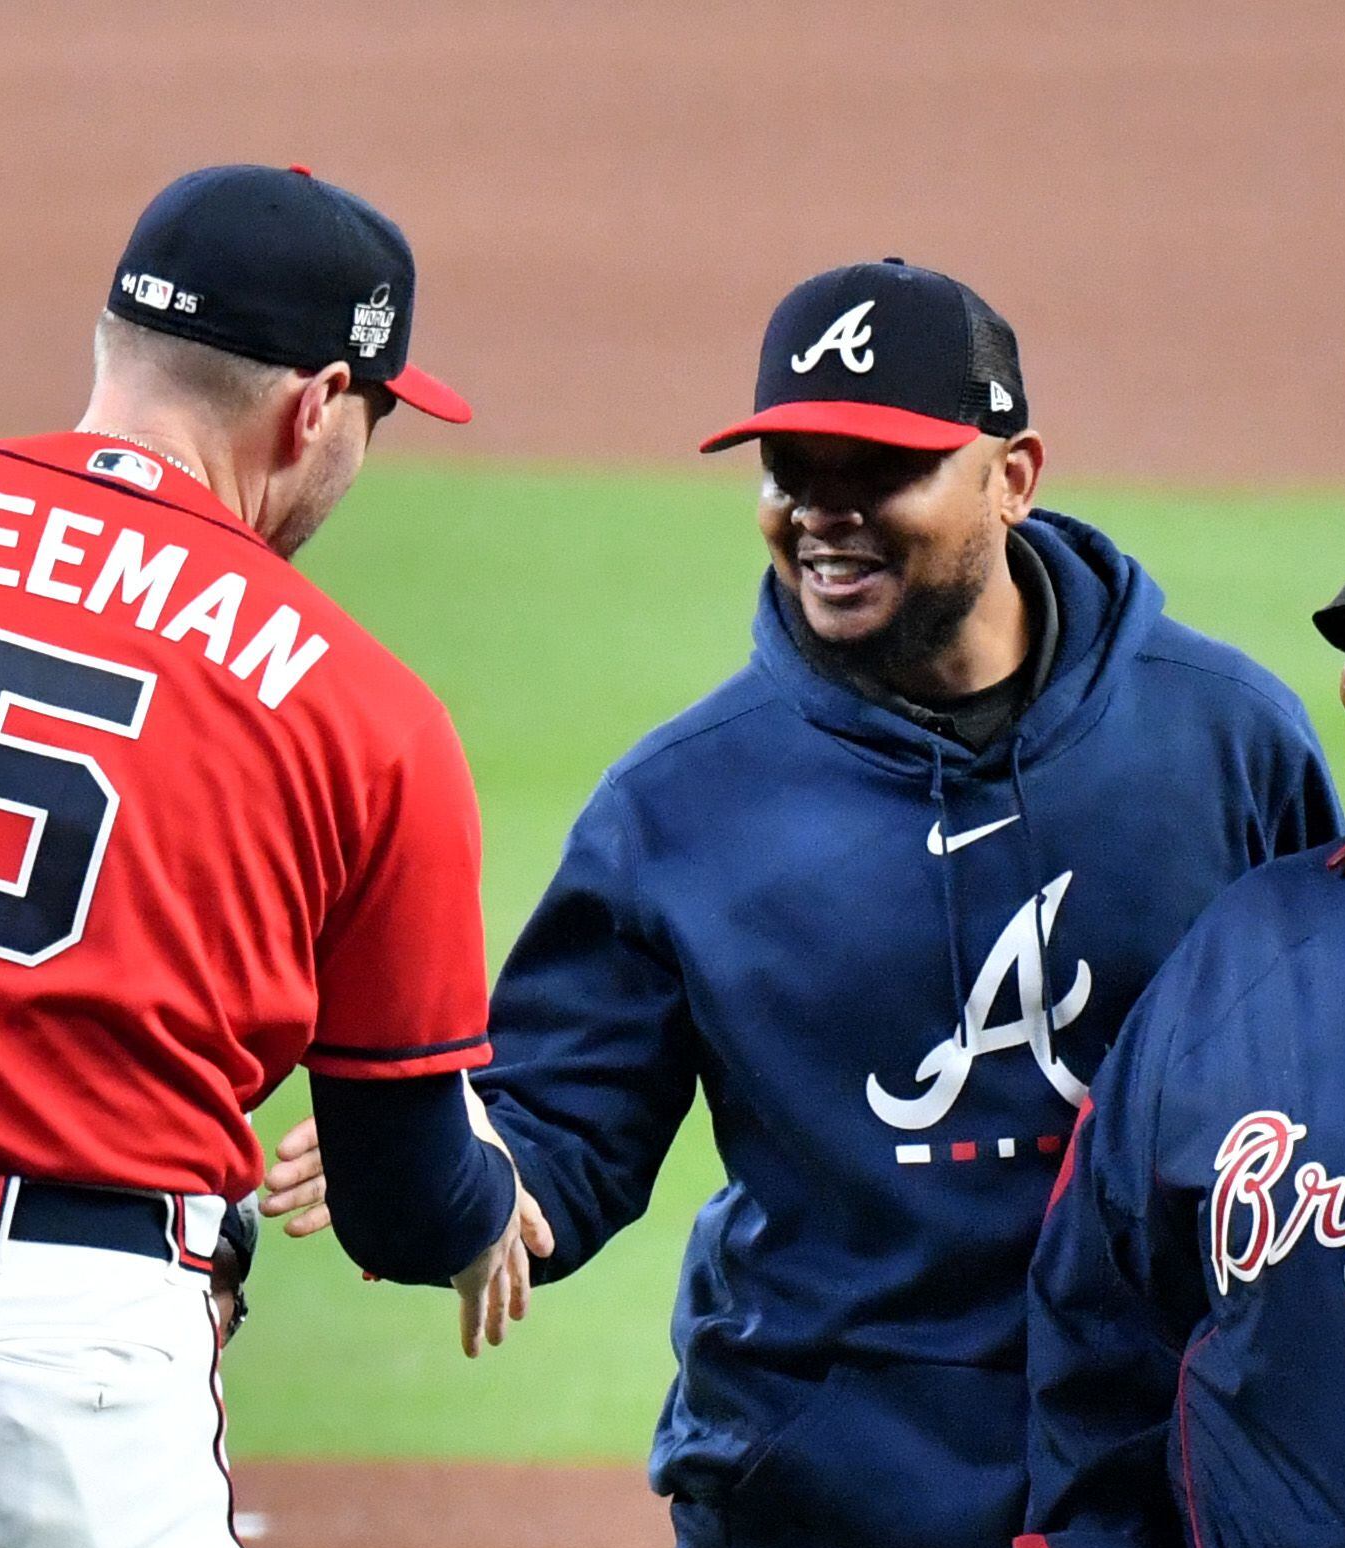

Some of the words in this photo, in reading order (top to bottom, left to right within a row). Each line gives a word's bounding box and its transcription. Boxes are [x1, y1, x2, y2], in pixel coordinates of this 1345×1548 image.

[121, 272, 137, 295] 44
[173, 291, 199, 314] 35
[353, 307, 395, 327] WORLD
[349, 325, 391, 344] SERIES
[791, 299, 876, 374] A
[865, 869, 1093, 1131] A
